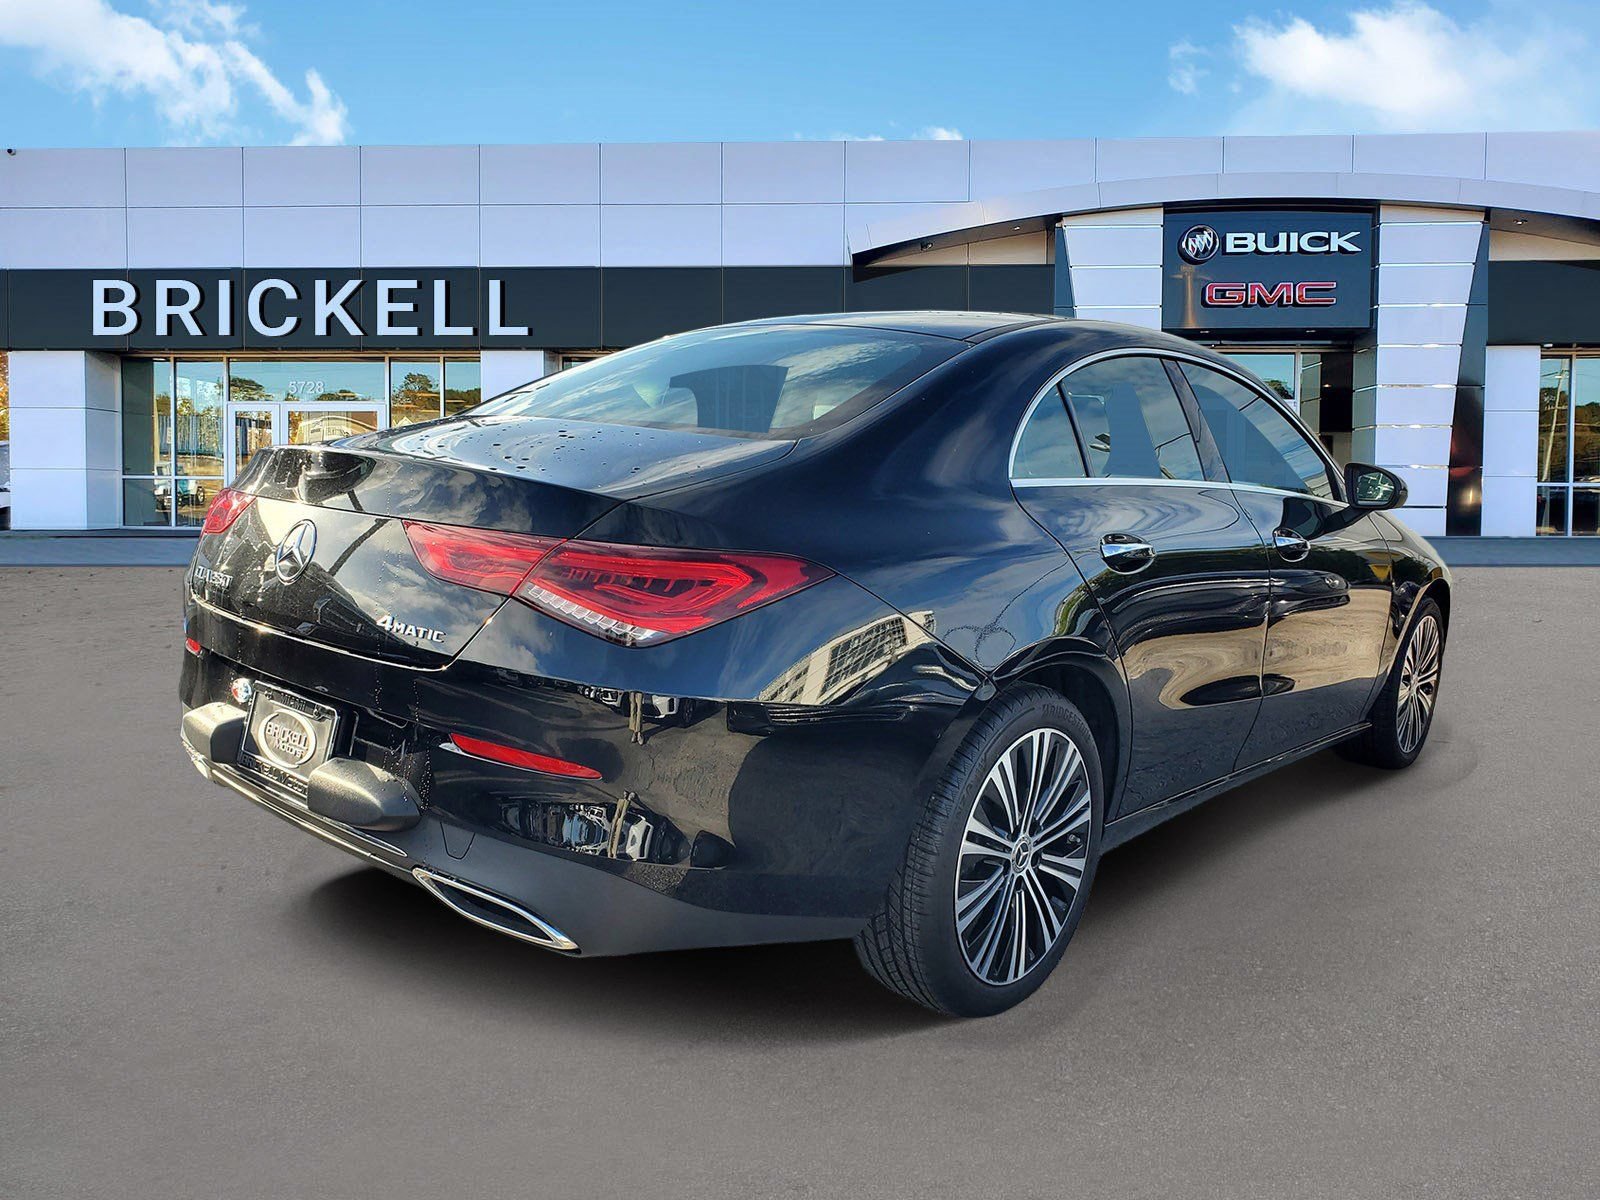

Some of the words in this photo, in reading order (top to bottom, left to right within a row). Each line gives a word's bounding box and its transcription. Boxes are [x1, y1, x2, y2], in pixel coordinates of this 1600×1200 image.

[1226, 231, 1362, 254] BUICK
[1205, 281, 1338, 306] GMC
[92, 279, 531, 337] BRICKELL
[288, 380, 325, 395] 5728
[376, 614, 446, 643] 4MATIC
[265, 721, 309, 751] BRICKELL
